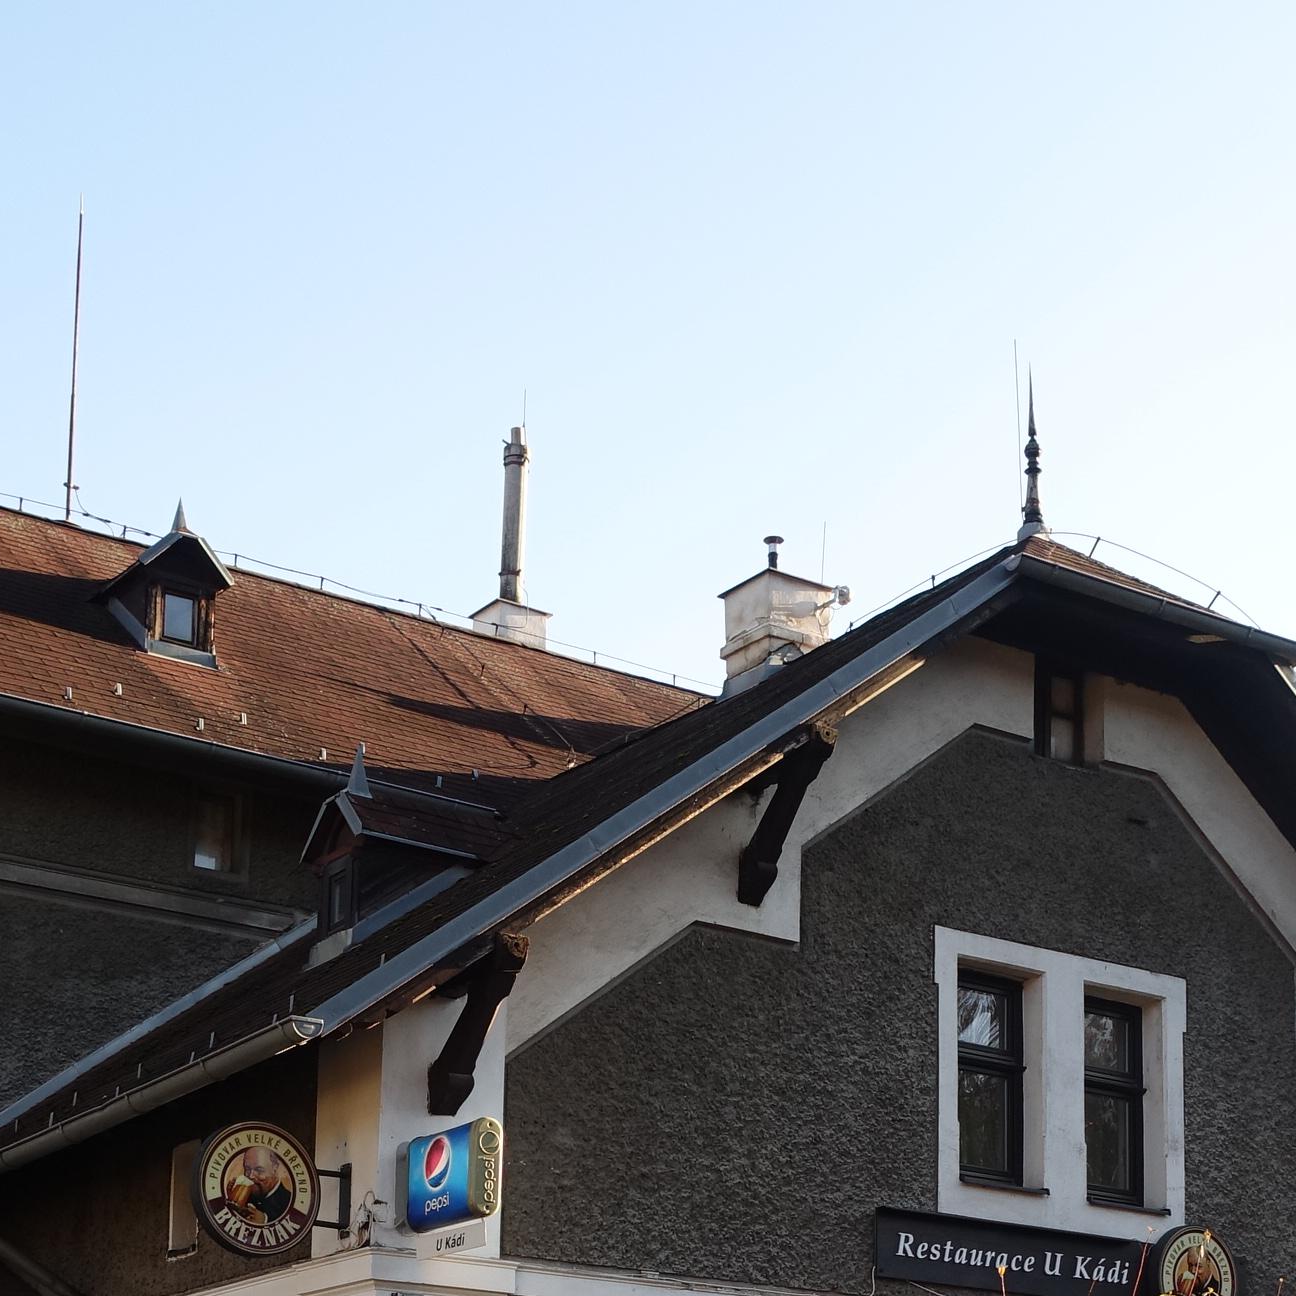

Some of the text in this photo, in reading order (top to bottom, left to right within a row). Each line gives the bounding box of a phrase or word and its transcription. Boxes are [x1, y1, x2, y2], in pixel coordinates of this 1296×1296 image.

[209, 1133, 308, 1194] PIVOVAR VELKÉ BŘEZNO
[478, 1155, 496, 1204] pepsi
[424, 1191, 450, 1215] pepsi
[213, 1205, 301, 1247] BŘEZŇÁK
[436, 1233, 465, 1251] U Kádi
[895, 1231, 1130, 1286] Restaurace U Kádi
[1165, 1240, 1186, 1275] PIVOVAR
